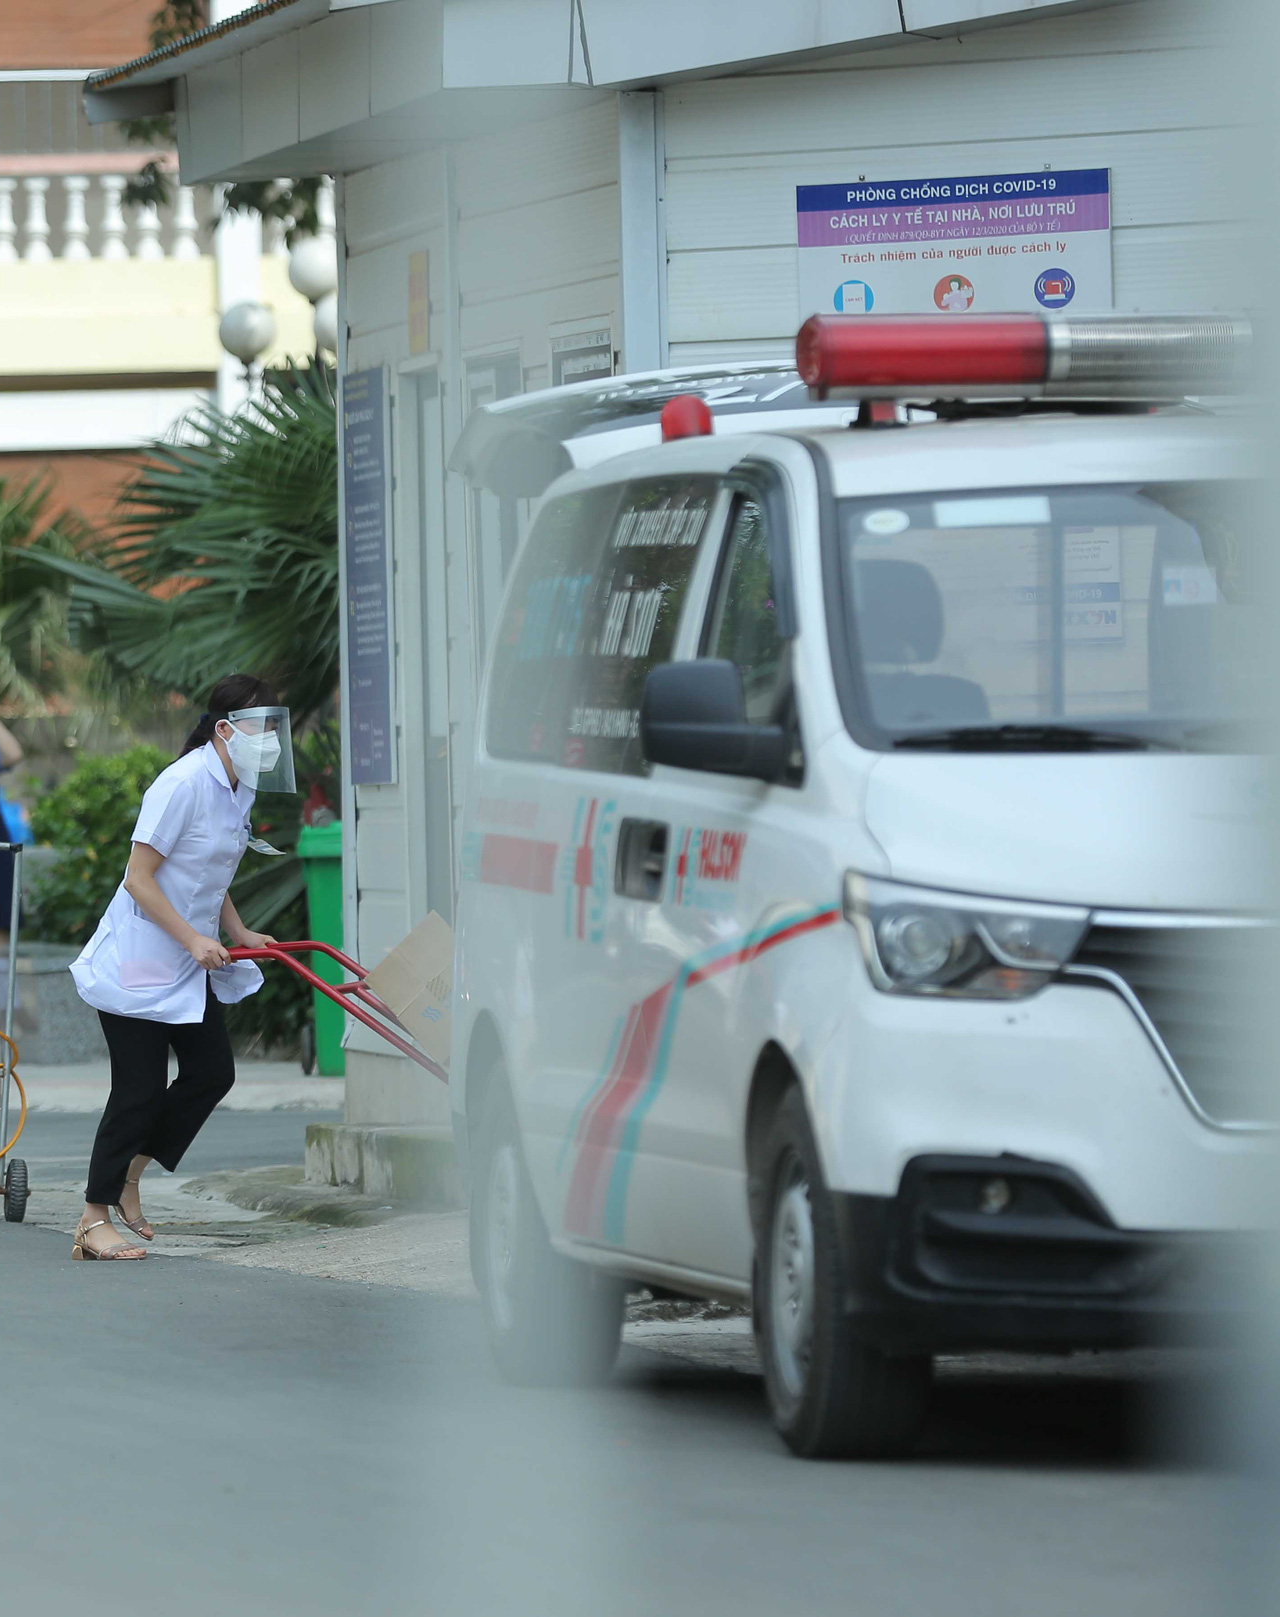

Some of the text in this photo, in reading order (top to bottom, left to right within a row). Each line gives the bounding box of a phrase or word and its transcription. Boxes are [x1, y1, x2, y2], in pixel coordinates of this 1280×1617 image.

[846, 178, 1057, 202] PHÒNG CHỐNG DỊCH COVID-19
[830, 199, 1076, 229] CÁCH LY Y TẾ TẠI NHÀ, NƠI LƯU TRÚ
[841, 241, 1066, 264] Trách nhiệm của người được cách ly
